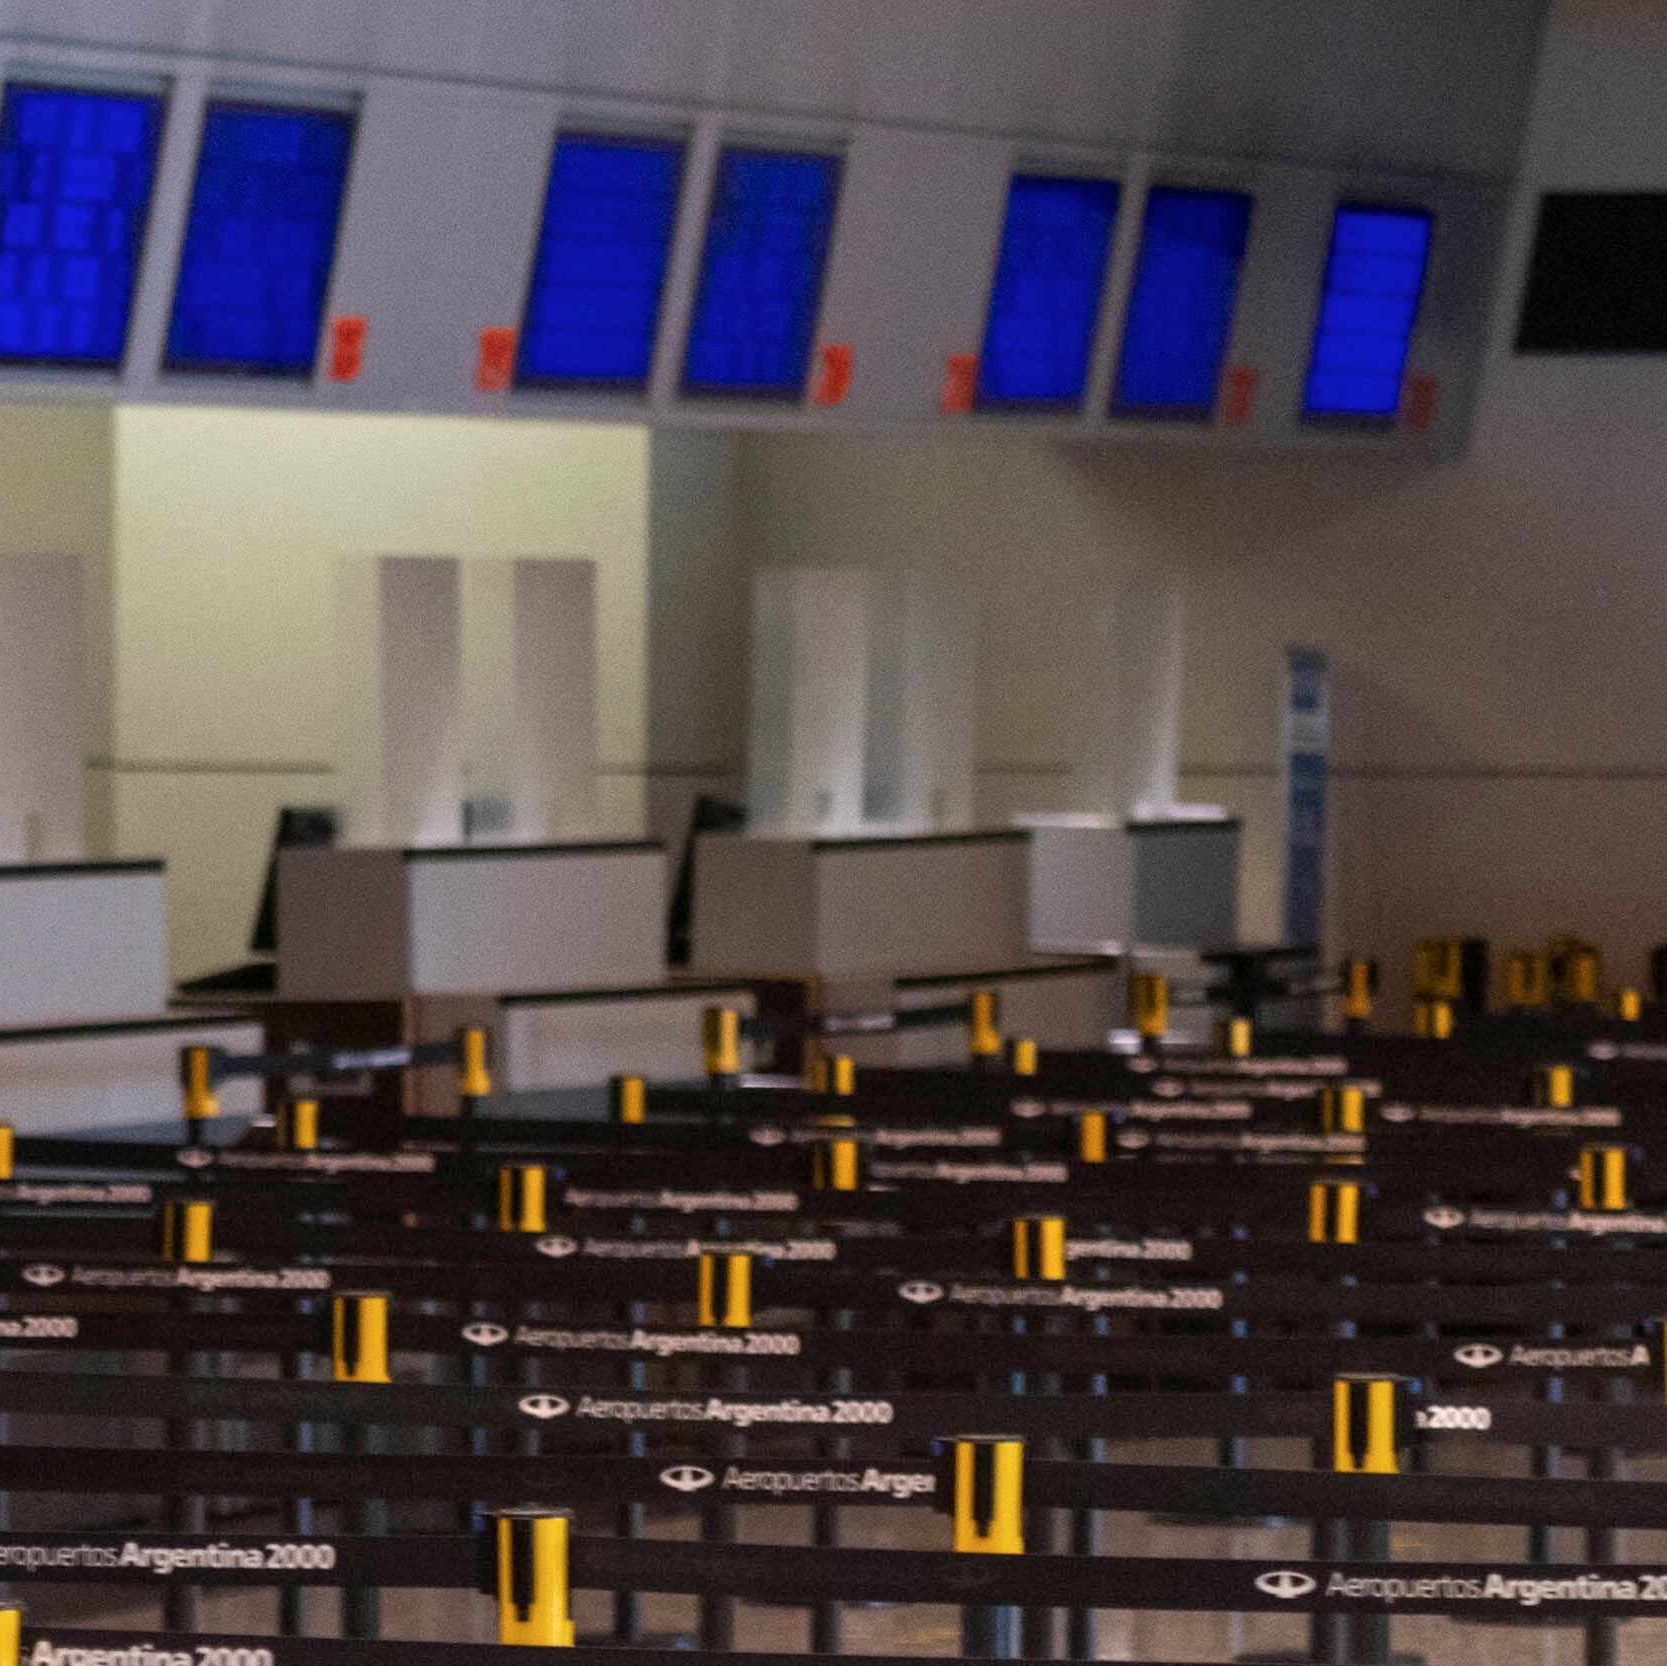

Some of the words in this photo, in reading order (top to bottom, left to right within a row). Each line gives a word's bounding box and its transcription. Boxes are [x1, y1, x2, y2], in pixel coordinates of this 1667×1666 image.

[707, 1398, 833, 1429] Argentina
[831, 1400, 895, 1424] 2000
[1426, 1405, 1493, 1430] 2000
[120, 1542, 267, 1574] Argentina
[266, 1543, 337, 1570] 2000
[1326, 1571, 1487, 1605] Aeropuertos
[1485, 1573, 1640, 1607] Argentina
